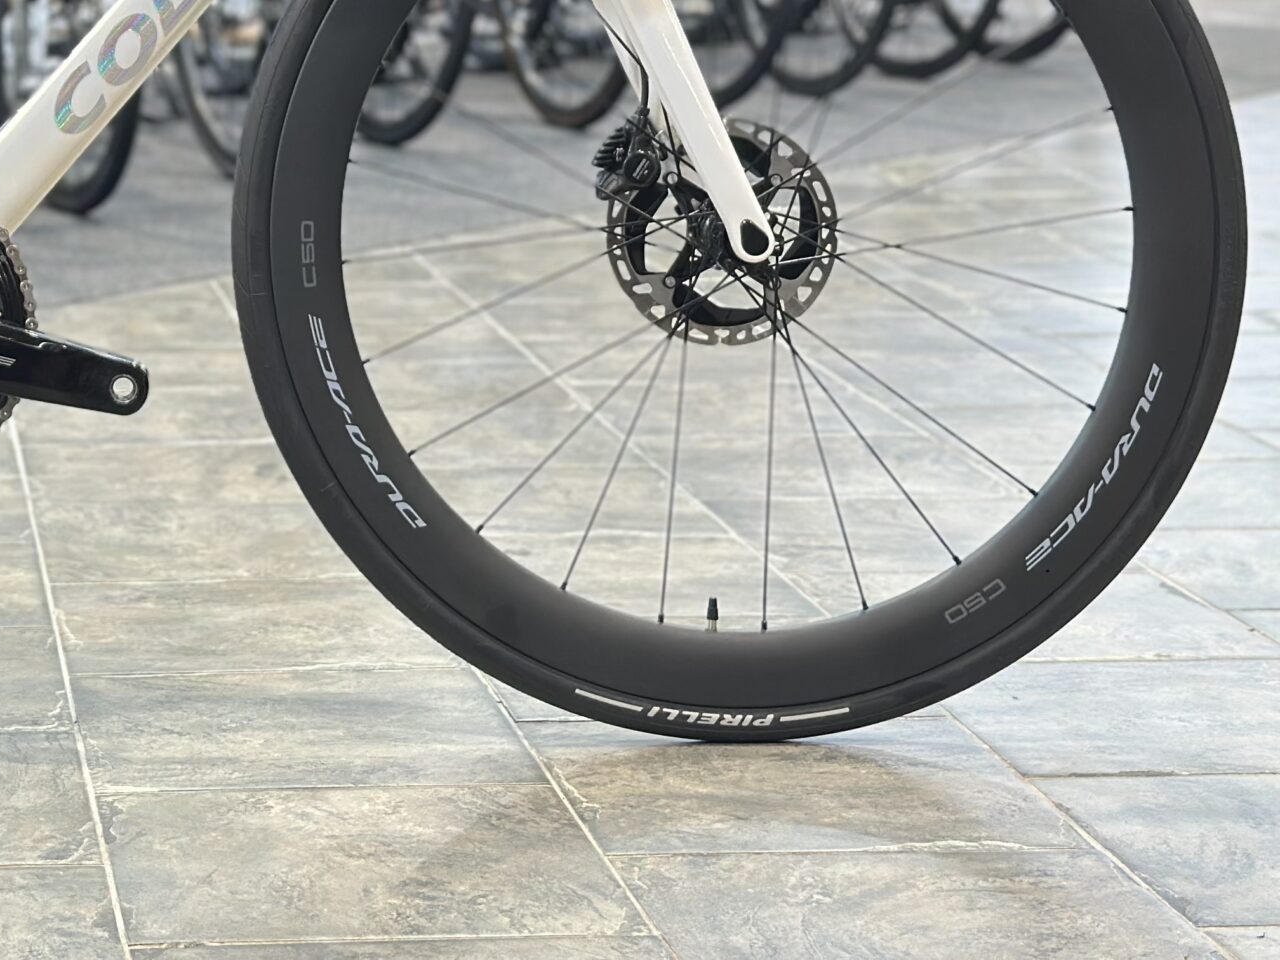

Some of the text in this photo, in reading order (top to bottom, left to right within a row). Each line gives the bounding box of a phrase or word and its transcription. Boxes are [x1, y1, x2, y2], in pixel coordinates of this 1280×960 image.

[300, 219, 318, 288] C50
[307, 313, 428, 529] DURA-ACE
[944, 362, 1164, 624] DURA-ACE C50
[646, 706, 775, 727] PIRELLI
